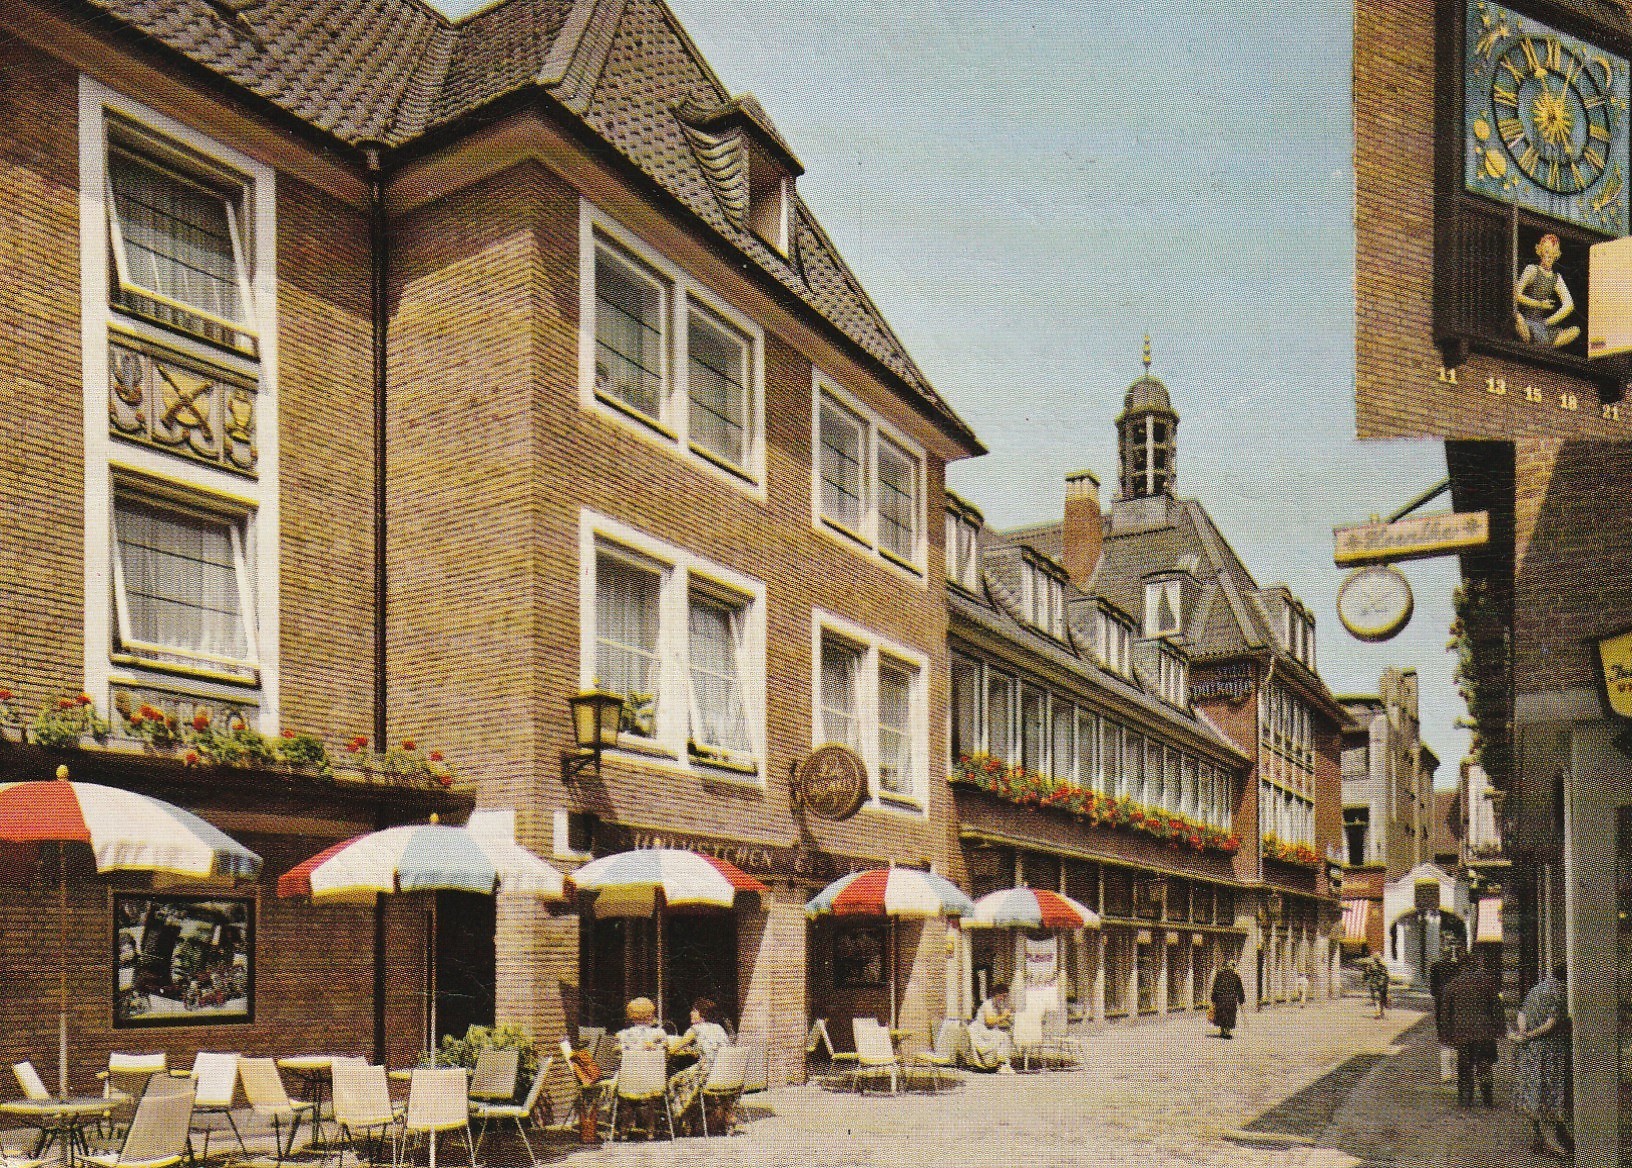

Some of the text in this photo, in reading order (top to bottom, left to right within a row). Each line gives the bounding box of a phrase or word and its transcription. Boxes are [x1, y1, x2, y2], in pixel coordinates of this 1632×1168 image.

[1437, 366, 1458, 386] 11
[1485, 376, 1506, 396] 13
[1525, 385, 1543, 403] 15
[1602, 403, 1619, 421] 21
